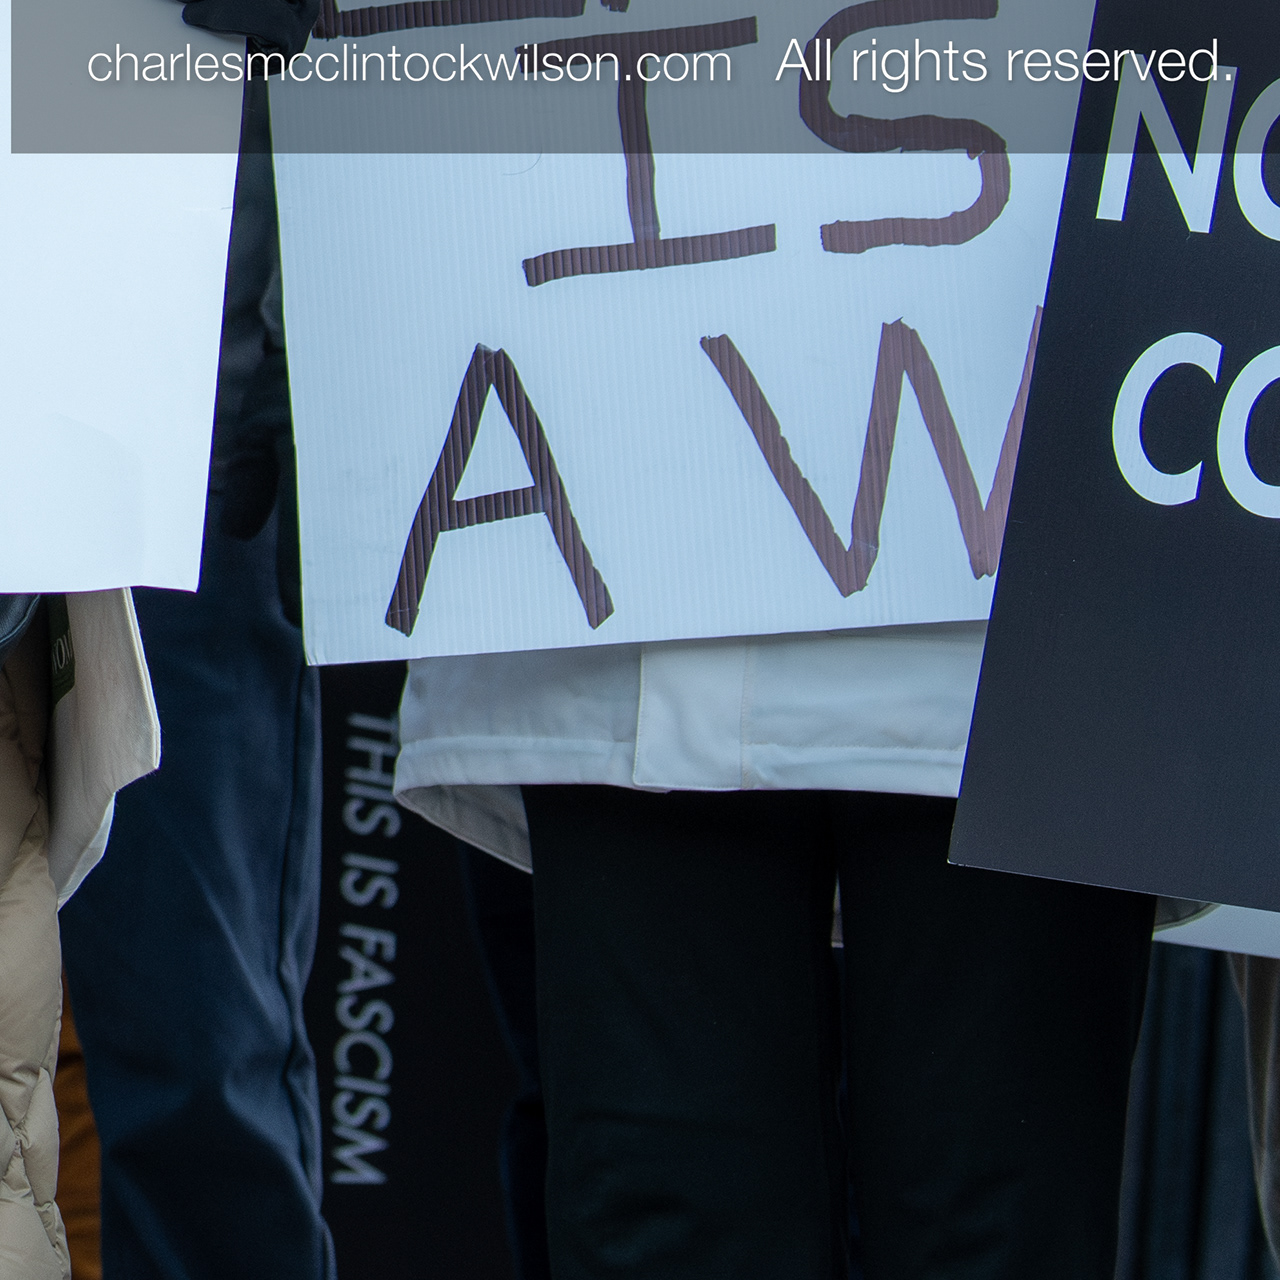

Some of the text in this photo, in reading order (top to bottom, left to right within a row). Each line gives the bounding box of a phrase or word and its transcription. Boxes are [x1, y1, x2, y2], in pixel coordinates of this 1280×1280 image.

[331, 712, 402, 1186] THIS IS FASCISM
